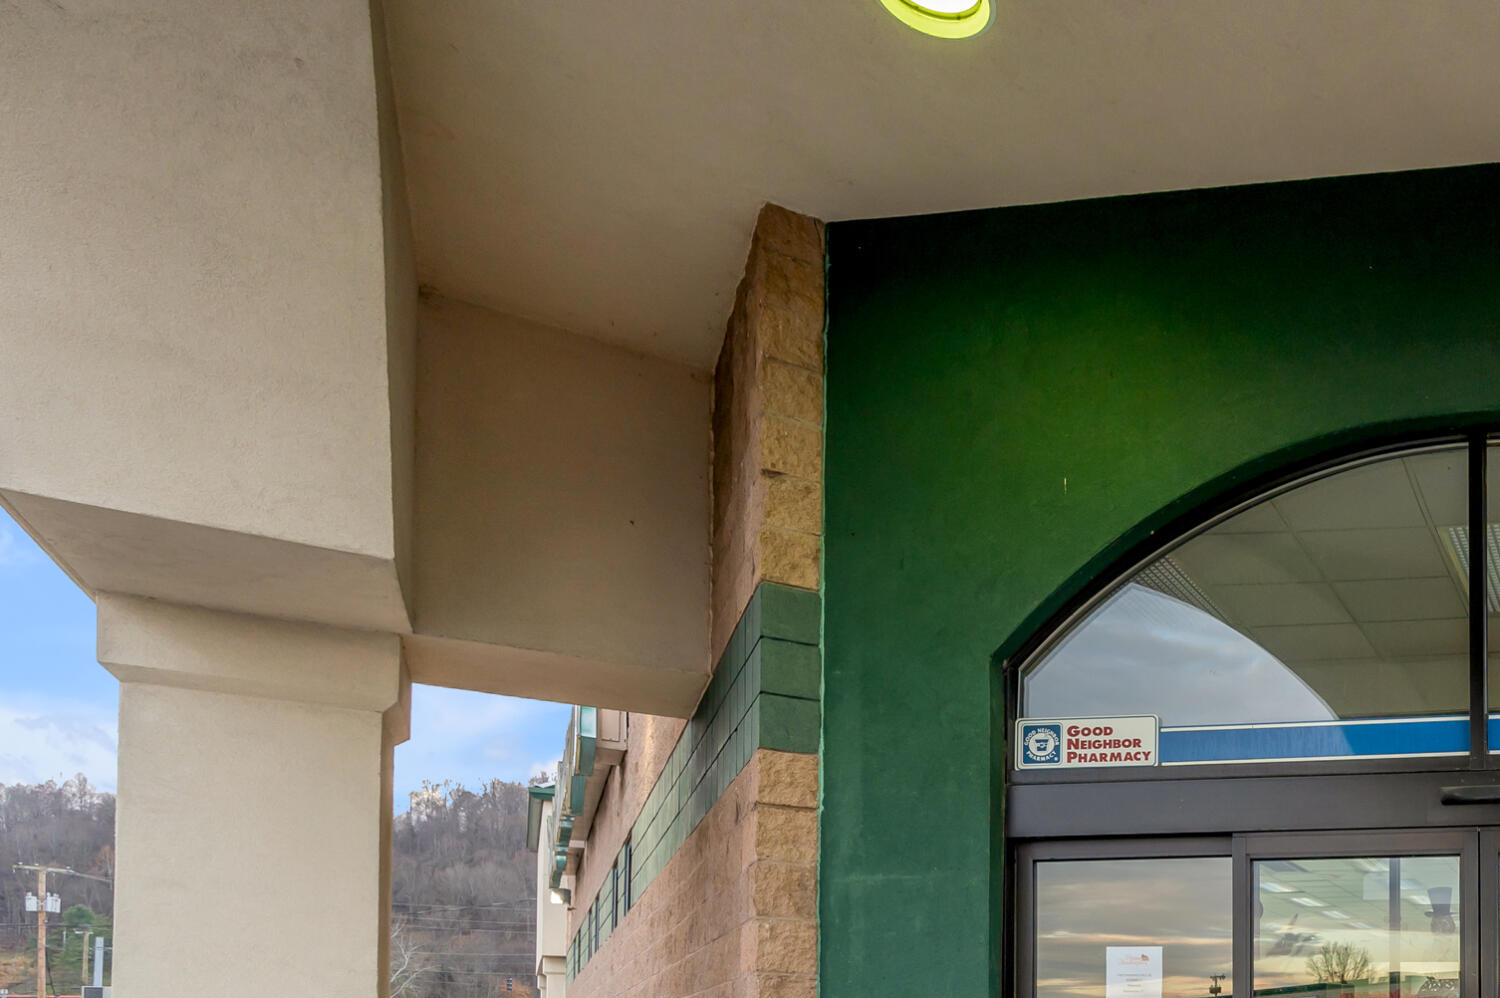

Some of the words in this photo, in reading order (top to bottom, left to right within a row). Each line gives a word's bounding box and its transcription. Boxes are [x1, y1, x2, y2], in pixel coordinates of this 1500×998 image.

[1067, 726, 1113, 737] GOOD
[1067, 738, 1142, 750] NEIGHBOR
[1067, 751, 1151, 763] PHARMACY
